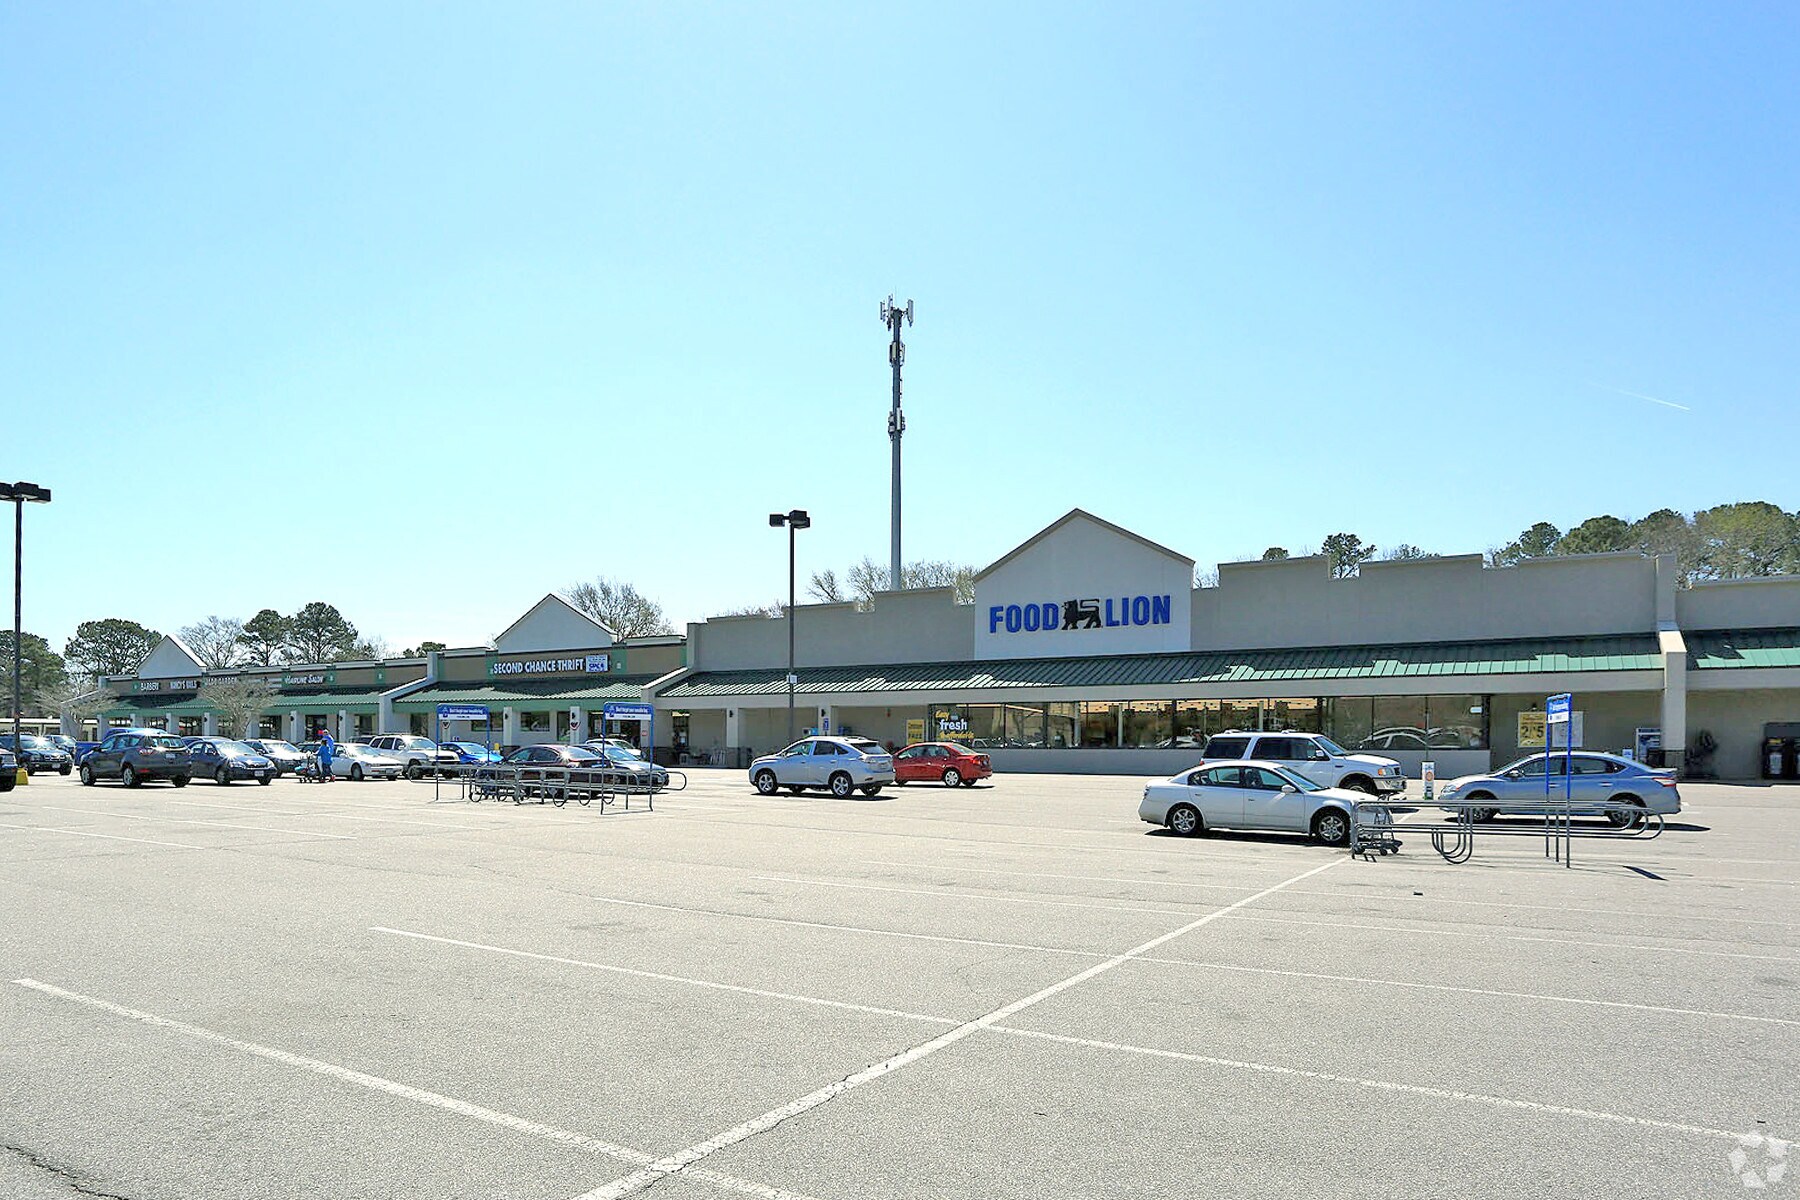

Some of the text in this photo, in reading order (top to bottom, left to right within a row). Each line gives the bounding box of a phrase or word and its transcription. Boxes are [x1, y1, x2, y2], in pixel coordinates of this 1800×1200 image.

[989, 595, 1171, 634] FOOD LION
[493, 659, 584, 674] SECOND CHANCE THRIFT
[939, 718, 968, 730] fresh
